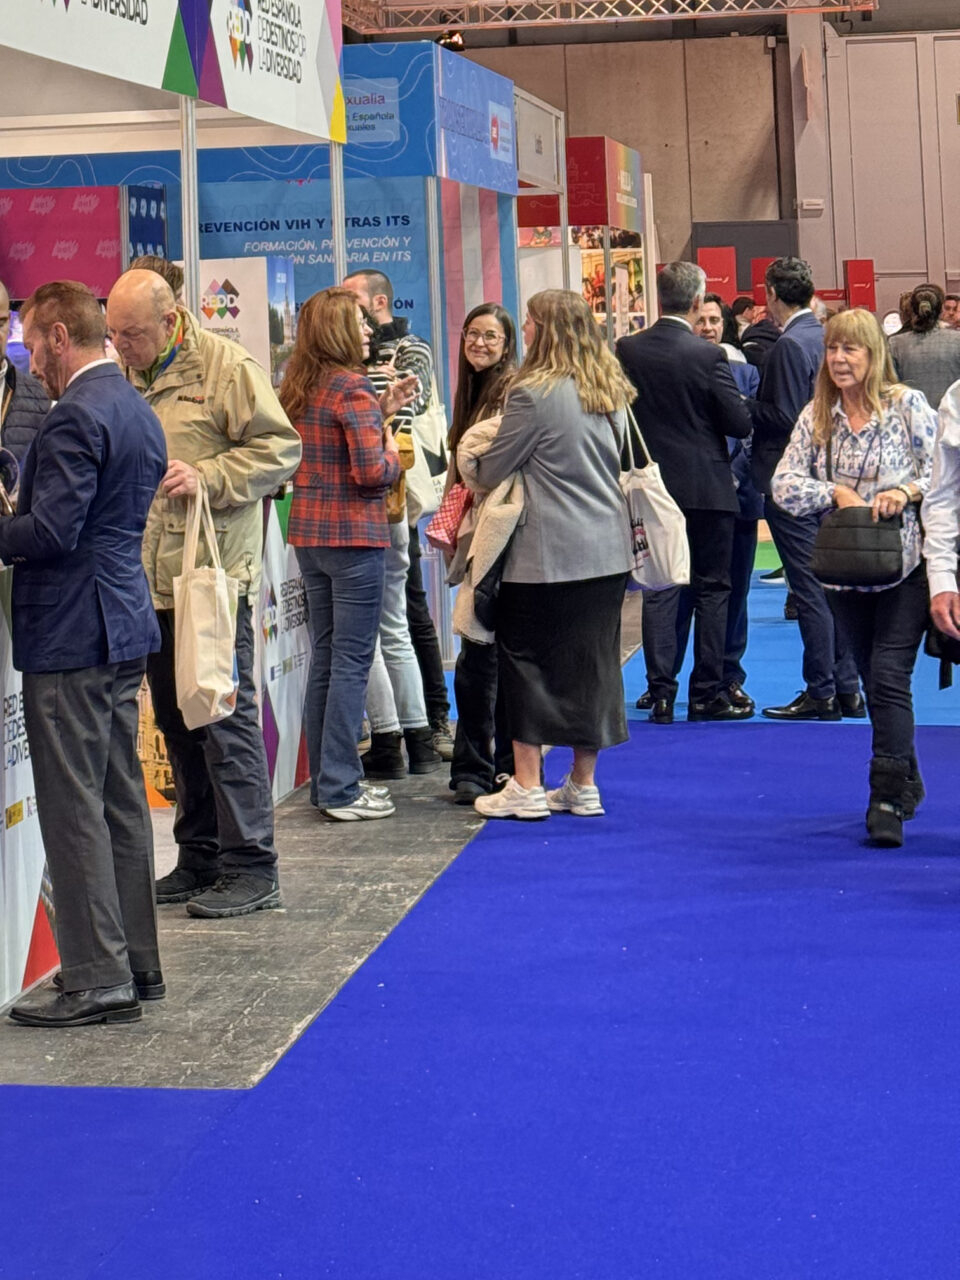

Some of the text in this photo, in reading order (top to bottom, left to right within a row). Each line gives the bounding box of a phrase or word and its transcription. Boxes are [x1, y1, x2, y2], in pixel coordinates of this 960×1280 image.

[345, 92, 385, 106] xualia
[198, 218, 280, 234] REVENCIÓN
[285, 219, 310, 231] VIH
[315, 218, 326, 230] Y
[386, 215, 410, 227] ITS
[244, 238, 318, 253] FORMACIÓN,
[403, 236, 412, 248] Y
[372, 252, 389, 263] EN
[392, 250, 411, 262] ITS
[201, 293, 237, 308] REDD
[4, 693, 18, 718] RED
